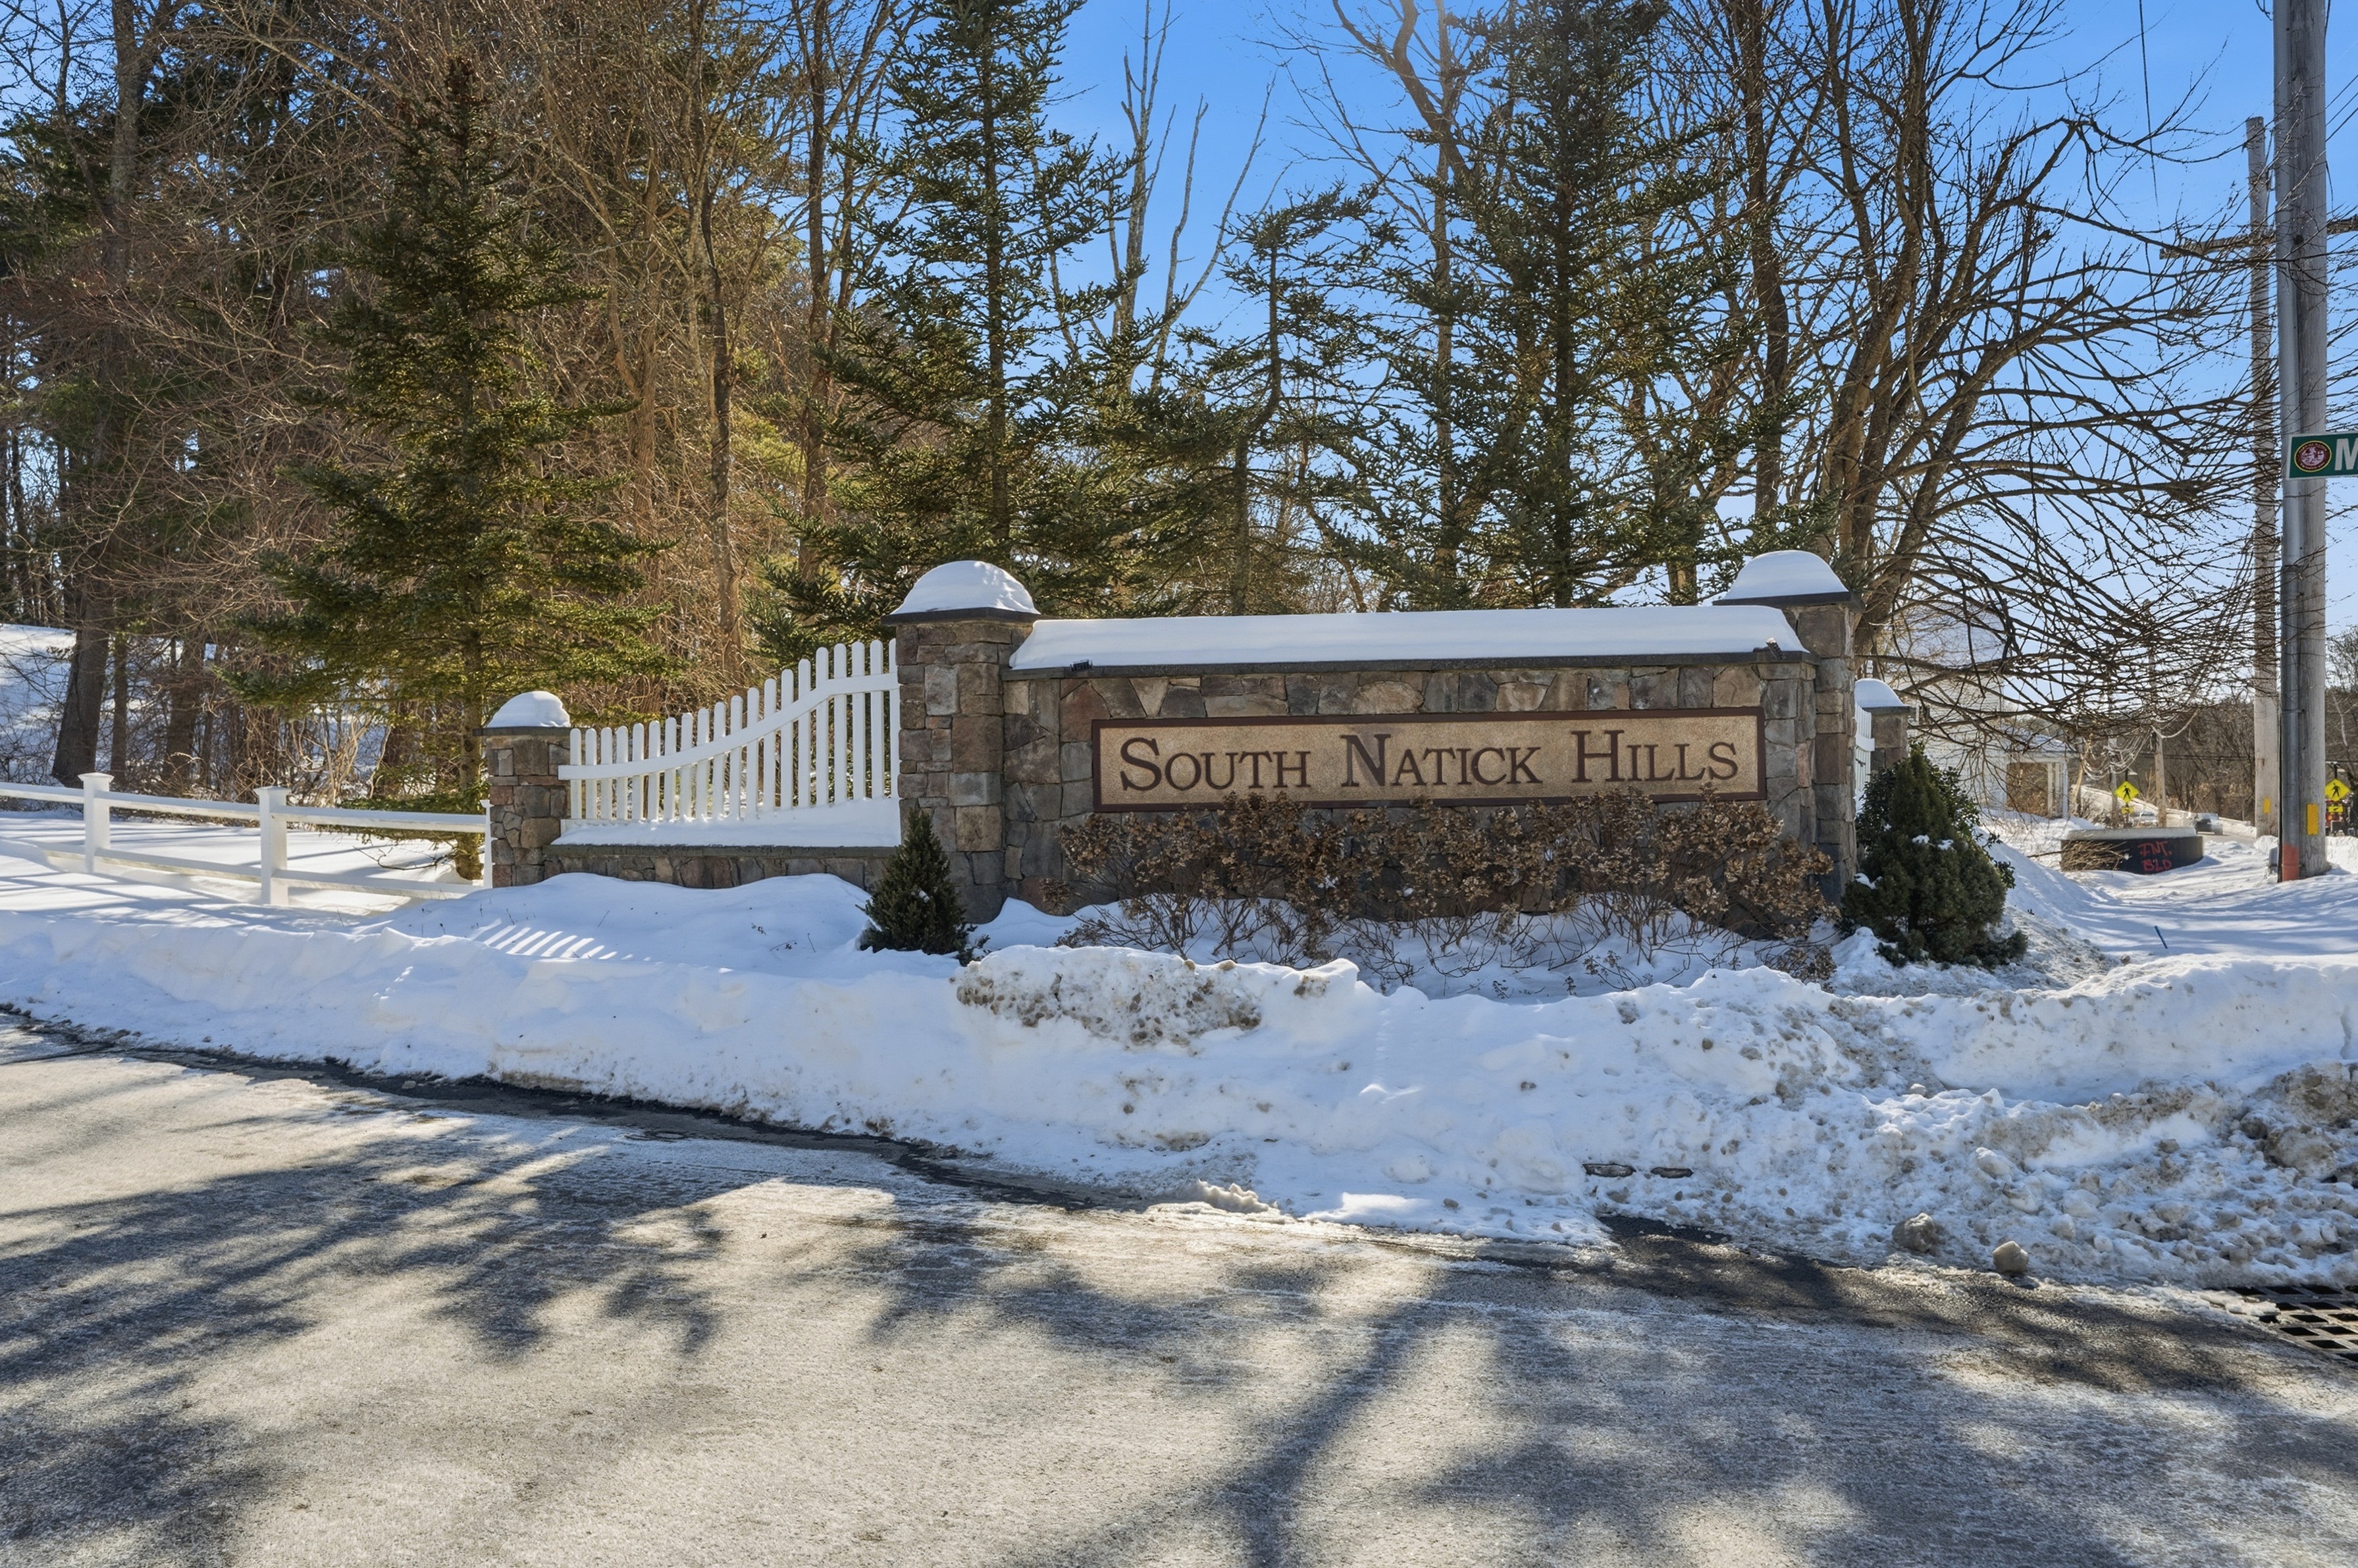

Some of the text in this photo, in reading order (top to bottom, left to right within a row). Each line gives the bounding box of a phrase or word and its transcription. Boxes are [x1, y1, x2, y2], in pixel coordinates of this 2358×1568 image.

[1120, 729, 1739, 791] SOUTH NATICK HILLS
